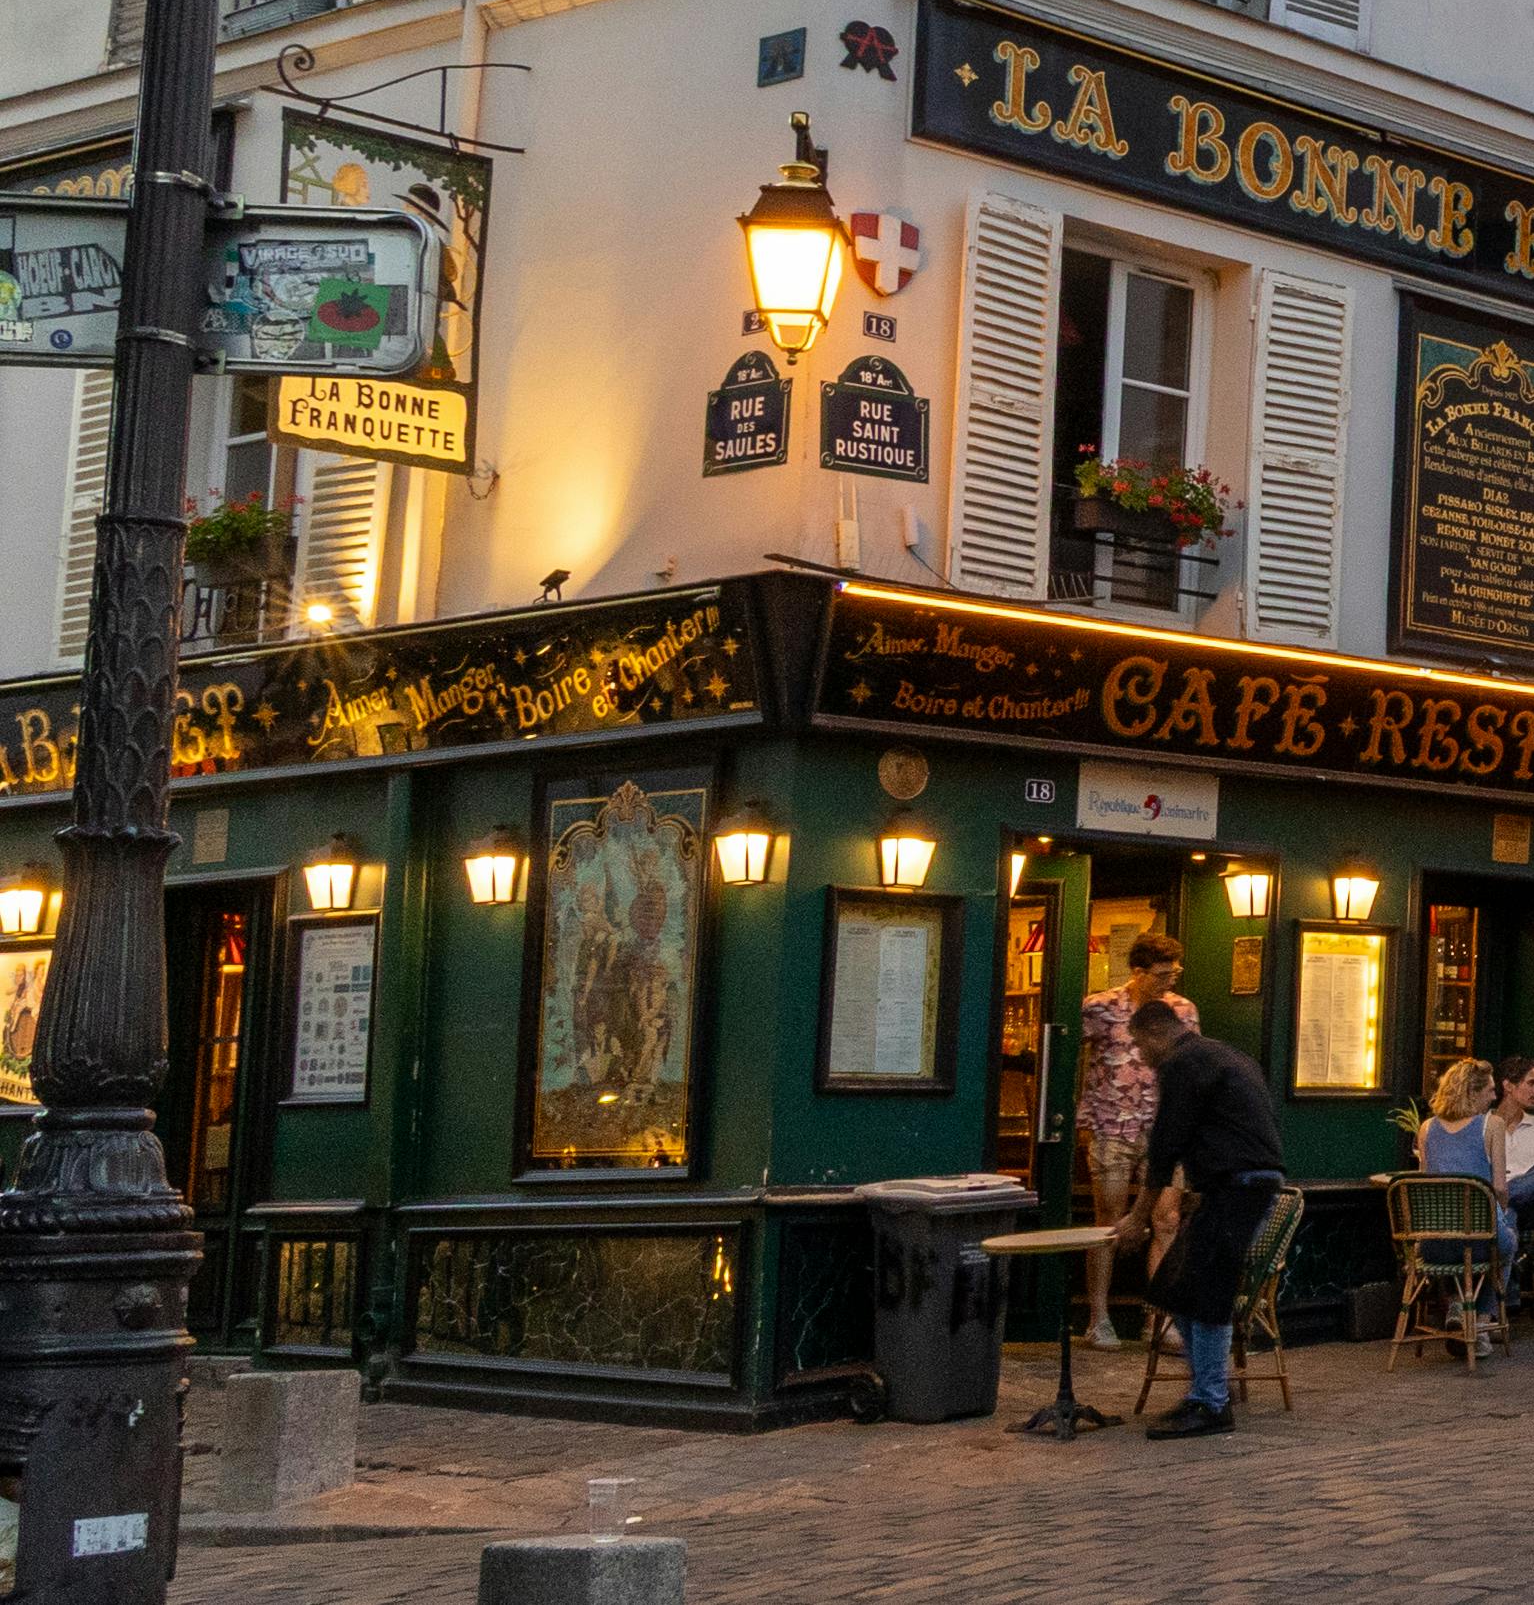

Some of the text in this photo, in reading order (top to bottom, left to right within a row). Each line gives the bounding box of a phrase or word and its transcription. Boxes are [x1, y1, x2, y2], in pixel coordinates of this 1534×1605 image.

[992, 39, 1129, 158] LA
[1166, 93, 1476, 257] BONNE
[869, 317, 891, 337] 18
[307, 376, 440, 420] LA BONNE
[731, 396, 765, 420] RUE
[860, 400, 892, 422] RUE
[289, 398, 455, 452] FRANQUETTE
[737, 421, 755, 433] DES
[852, 420, 900, 444] SAINT
[715, 433, 776, 460] SAULES
[835, 439, 915, 467] RUSTIQUE
[510, 666, 592, 730] Boire
[591, 680, 620, 720] et
[892, 681, 957, 718] Boire
[961, 695, 987, 720] et
[1101, 654, 1330, 757] CAFÉ
[1028, 781, 1052, 801] 18
